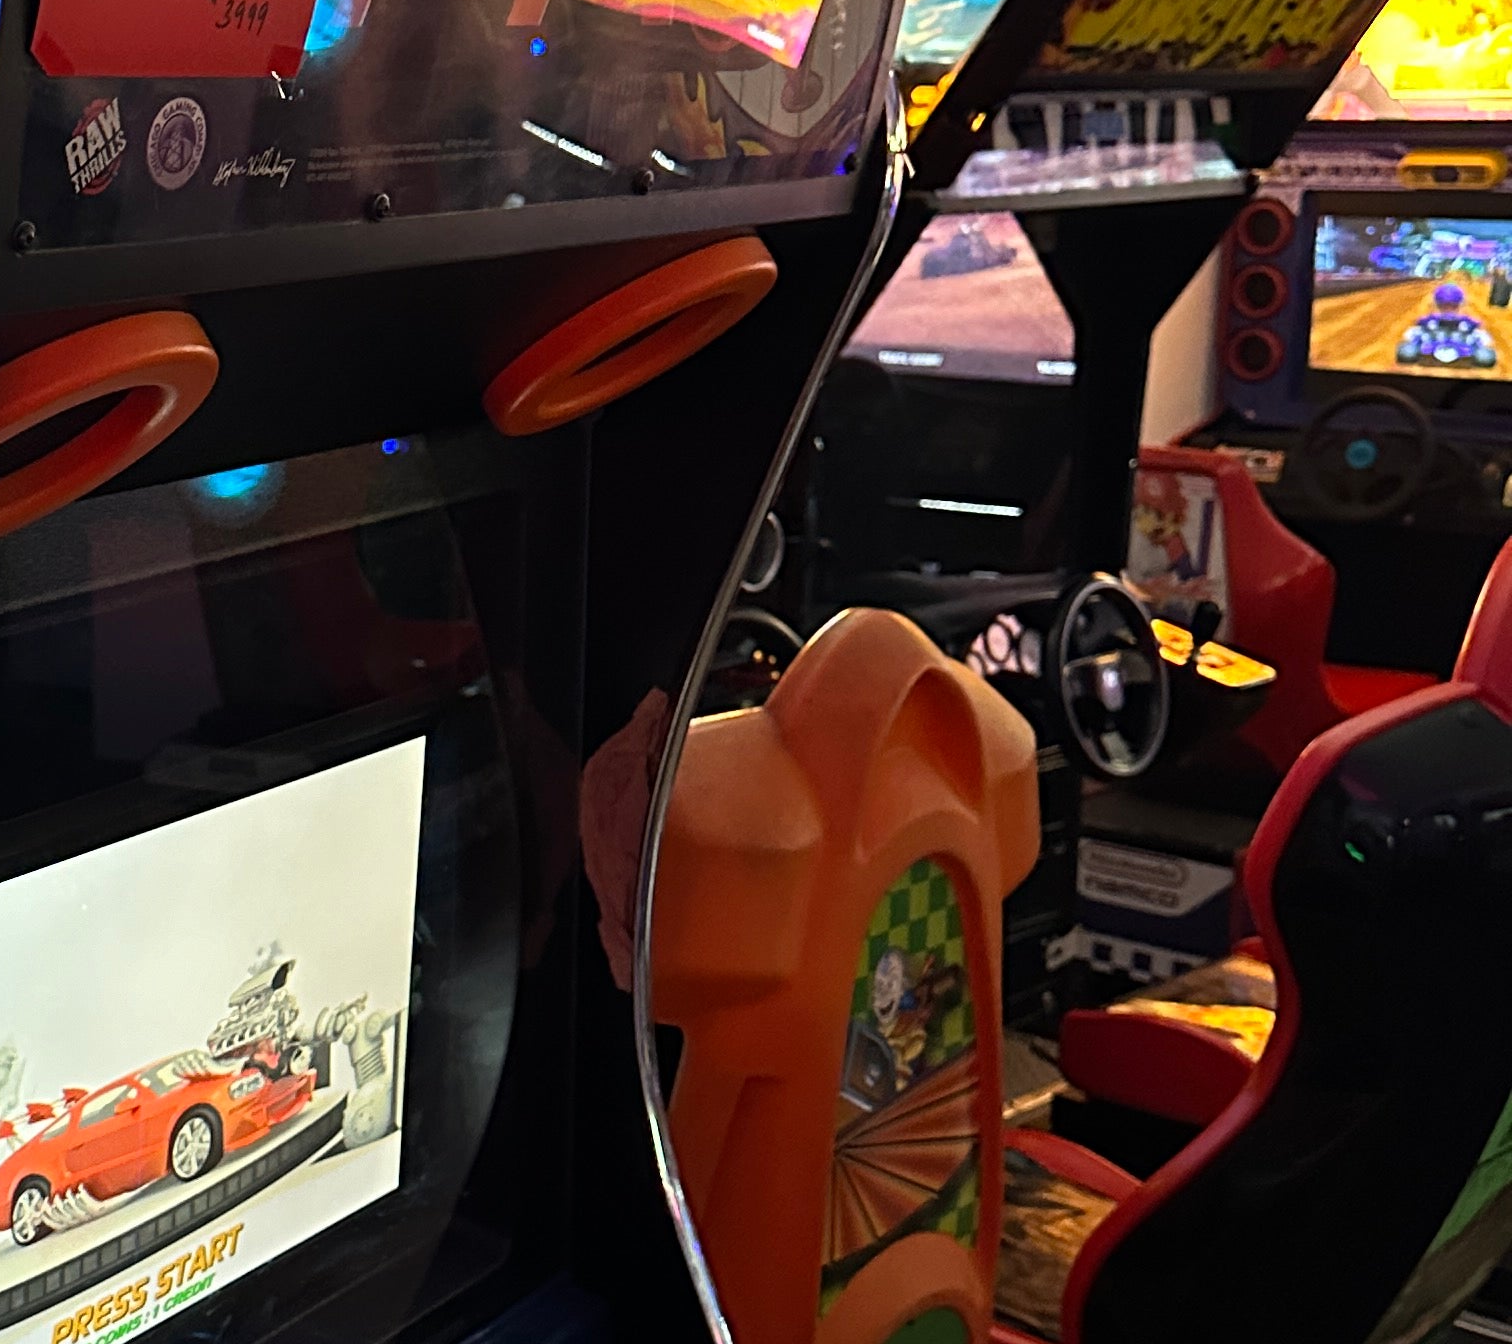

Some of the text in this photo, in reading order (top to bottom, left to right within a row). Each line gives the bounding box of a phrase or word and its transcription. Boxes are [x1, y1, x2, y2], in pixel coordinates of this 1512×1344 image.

[64, 97, 122, 175] RAW
[70, 129, 128, 195] THRILLS
[155, 1222, 245, 1301] START
[162, 1272, 216, 1313] CREDIT
